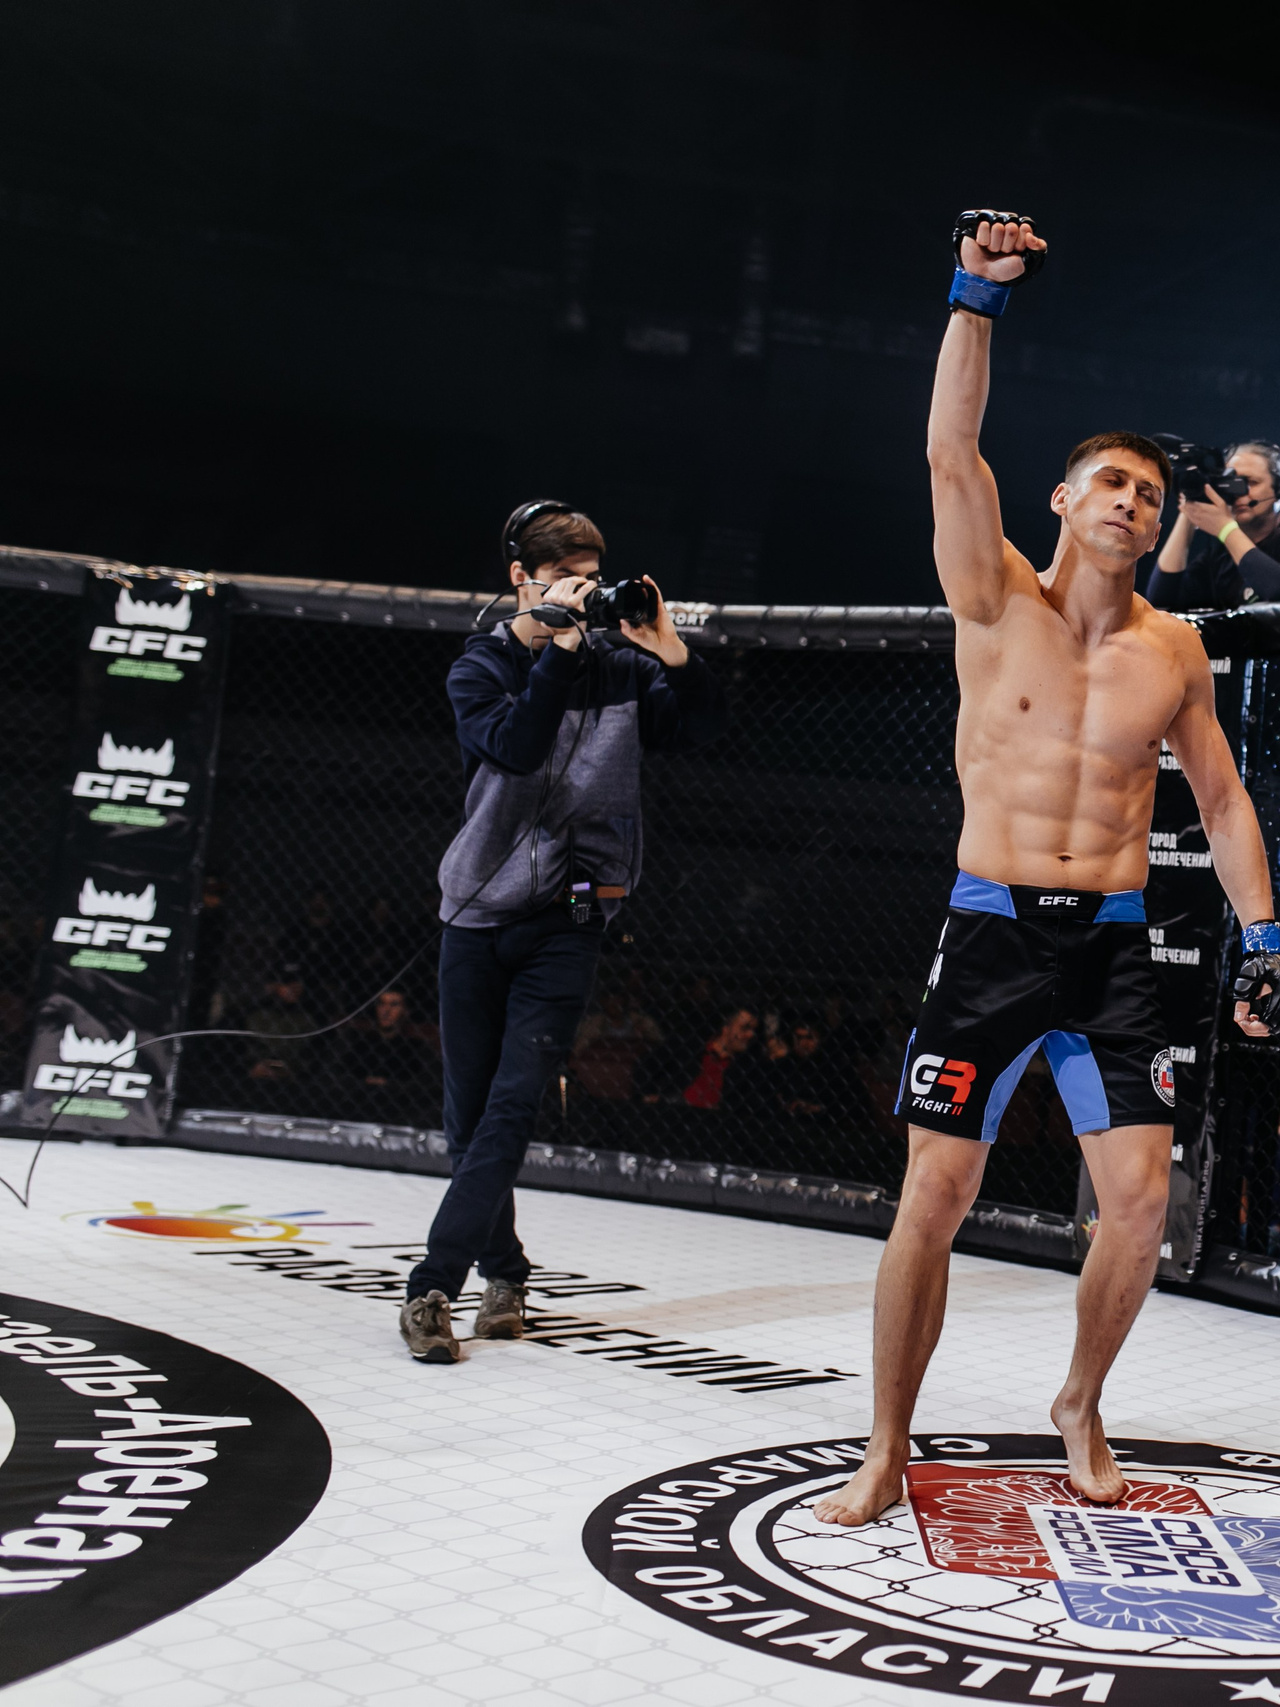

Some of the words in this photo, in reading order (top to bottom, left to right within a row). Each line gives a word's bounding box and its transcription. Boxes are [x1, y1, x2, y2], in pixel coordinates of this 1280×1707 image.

[89, 625, 208, 662] GFC
[72, 771, 191, 807] GFC
[1038, 896, 1079, 906] GFC
[52, 916, 172, 952] GFC
[1151, 945, 1201, 966] ВЛЕЧЕНИЙ
[33, 1064, 152, 1099] GFC
[911, 1096, 953, 1115] FIGHT
[1043, 1509, 1112, 1577] РОССИИ
[1086, 1512, 1179, 1578] ММА
[1150, 1517, 1242, 1588] СОЮЗ
[634, 1565, 1116, 1703] ОБЛАСТИ
